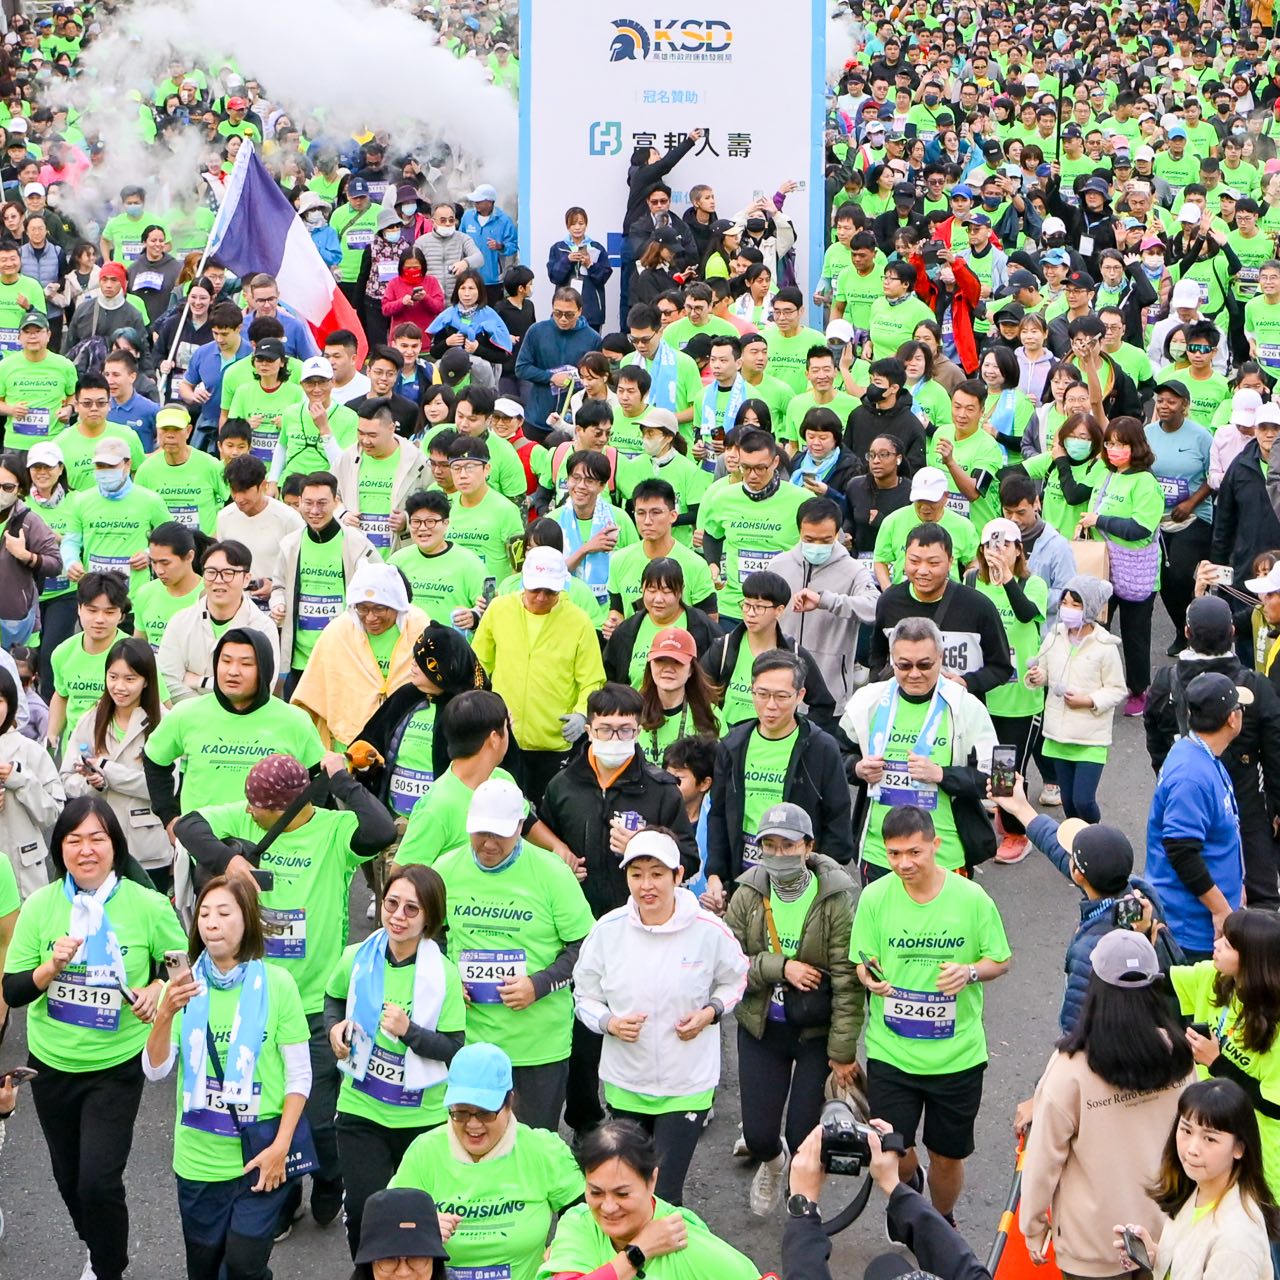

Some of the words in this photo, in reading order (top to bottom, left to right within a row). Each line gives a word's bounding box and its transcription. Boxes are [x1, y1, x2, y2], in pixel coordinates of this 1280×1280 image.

[653, 19, 733, 52] KSD
[730, 520, 782, 532] KAOHSIUNG
[303, 604, 336, 615] 52464
[201, 743, 275, 756] KAOHSIUNG
[453, 905, 533, 922] KAOHSIUNG
[888, 936, 964, 950] KAOHSIUNG
[466, 964, 517, 980] 52494
[56, 986, 111, 1005] 51319
[894, 1002, 947, 1019] 52462
[1086, 1097, 1112, 1111] Soser
[434, 1198, 526, 1221] KAOHSIUNG
